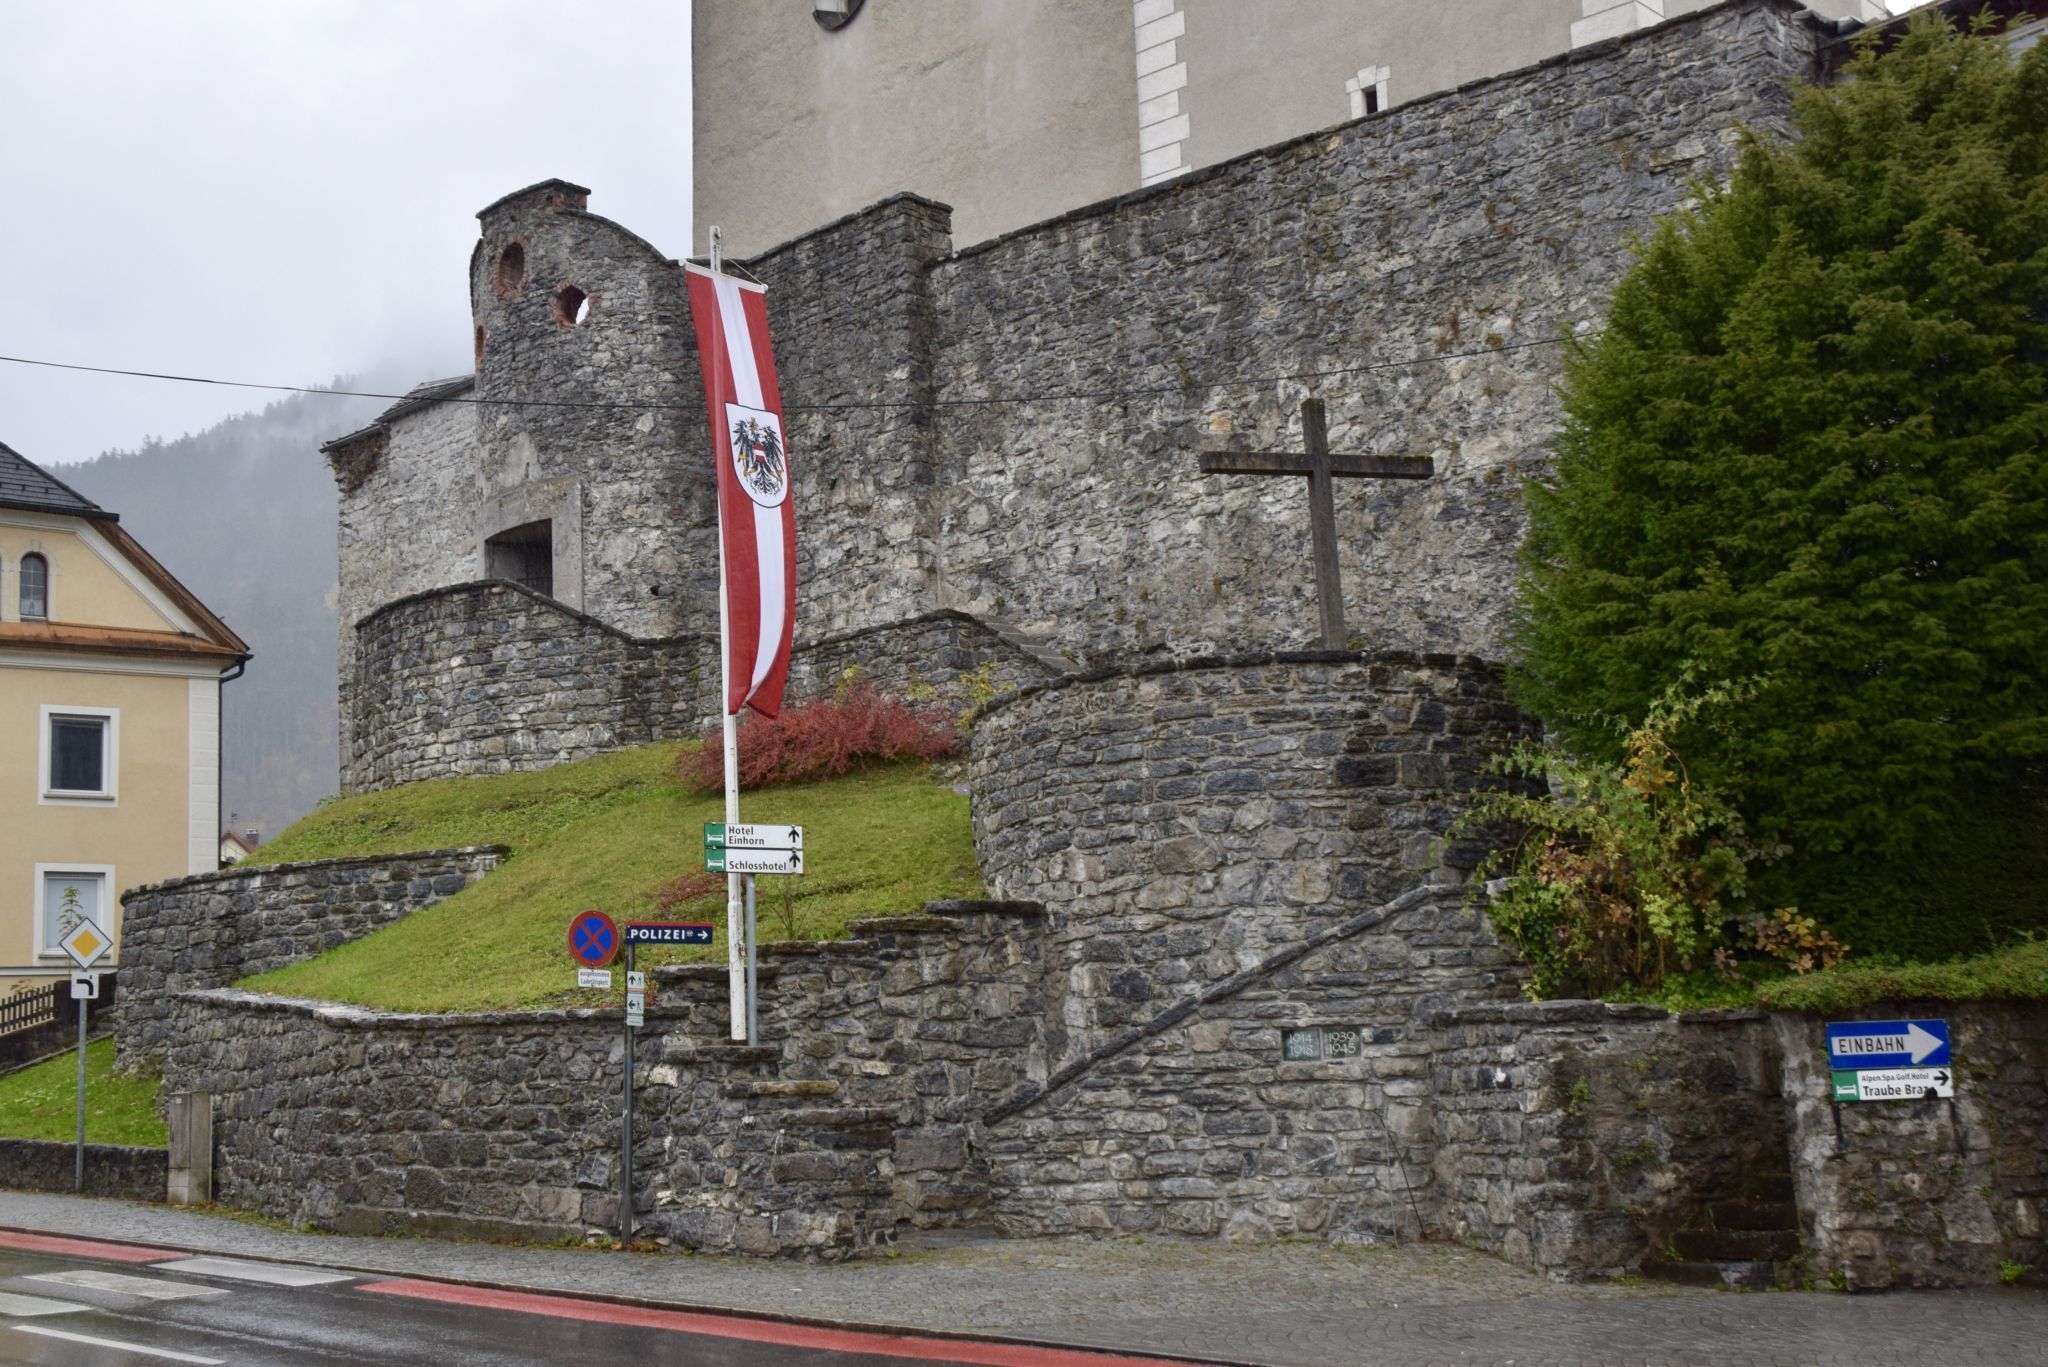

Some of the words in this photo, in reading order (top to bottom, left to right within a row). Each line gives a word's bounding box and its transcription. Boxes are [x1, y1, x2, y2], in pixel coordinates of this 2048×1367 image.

[729, 826, 754, 835] Hotel
[729, 836, 765, 845] Einhorn
[729, 861, 787, 871] Schlosshotel
[630, 929, 685, 940] POLIZEI
[1290, 1032, 1312, 1043] 1914
[1329, 1031, 1356, 1042] 1939
[1329, 1043, 1357, 1055] 1945
[1839, 1036, 1905, 1054] EINBAHN
[1290, 1045, 1314, 1058] 1918
[1863, 1085, 1902, 1097] Traube
